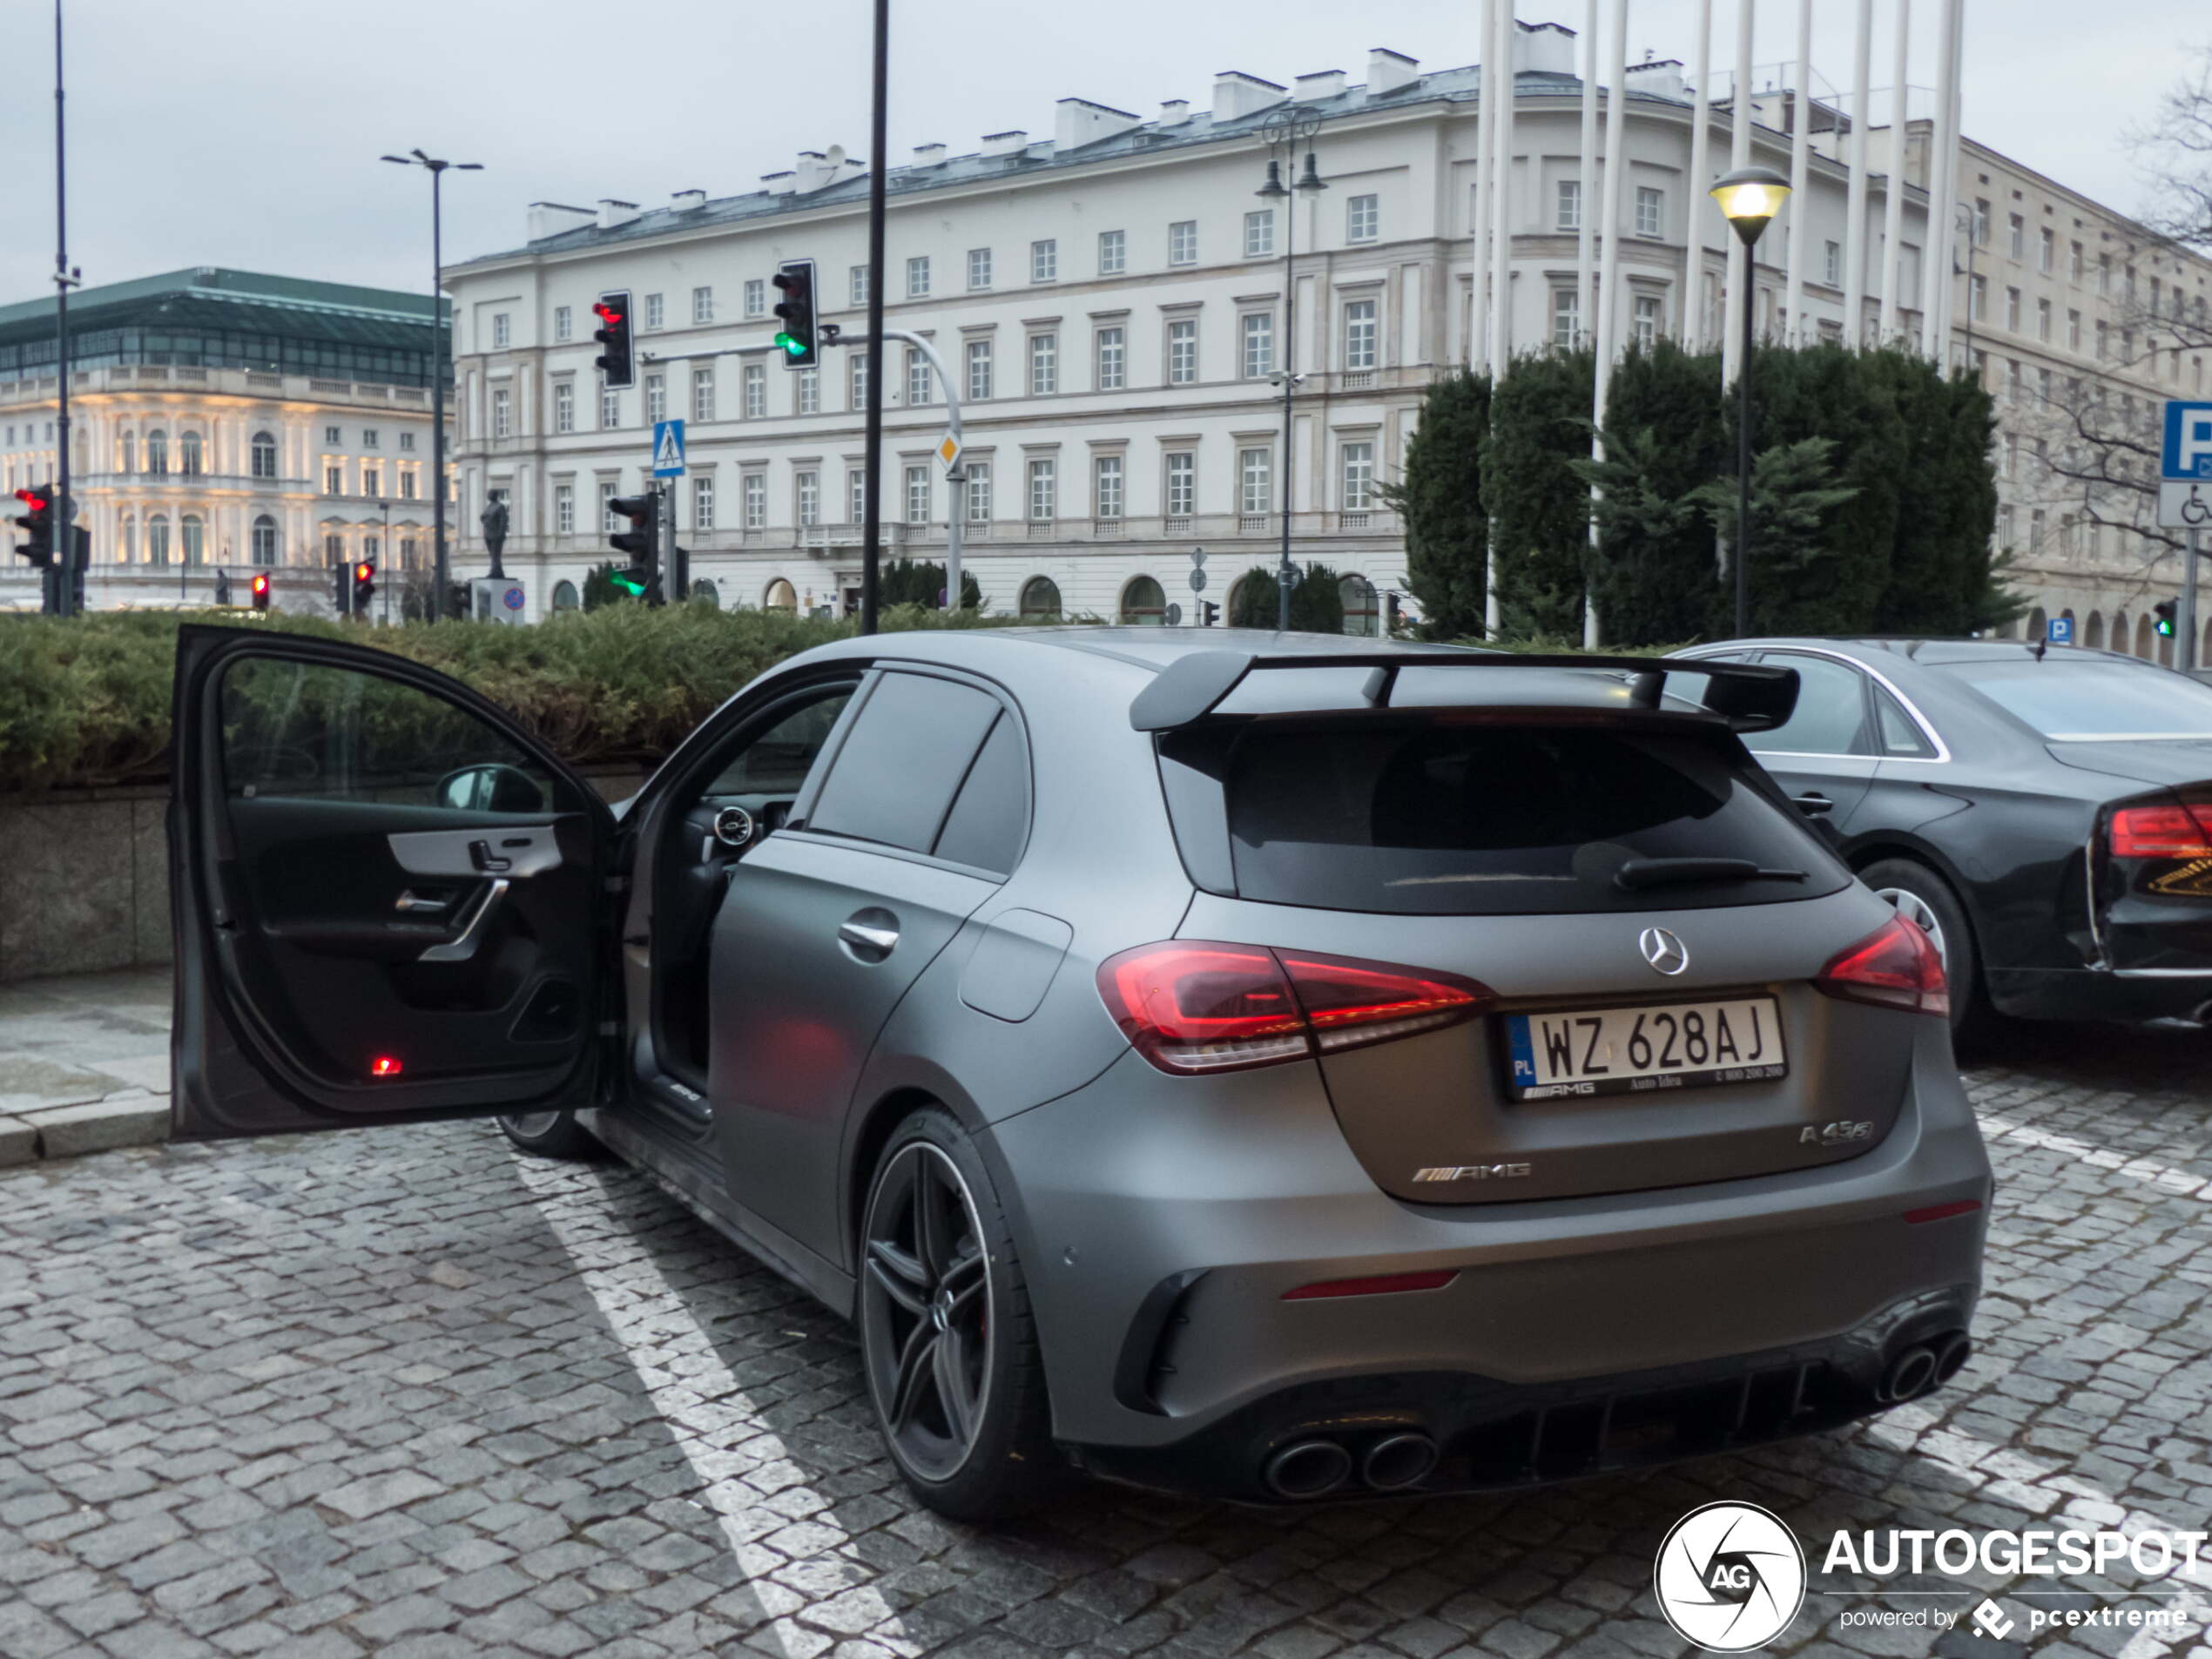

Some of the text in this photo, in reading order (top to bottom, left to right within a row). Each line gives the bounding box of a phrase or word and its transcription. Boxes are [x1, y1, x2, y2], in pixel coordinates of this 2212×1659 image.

[2179, 409, 2212, 469] P
[2053, 621, 2067, 638] P
[1542, 1005, 1763, 1077] WZ 628AJ
[1514, 1059, 1533, 1076] PL
[1550, 1082, 1595, 1096] AMG
[1630, 1074, 1682, 1089] Auto Idea
[1452, 1163, 1532, 1180] AMG
